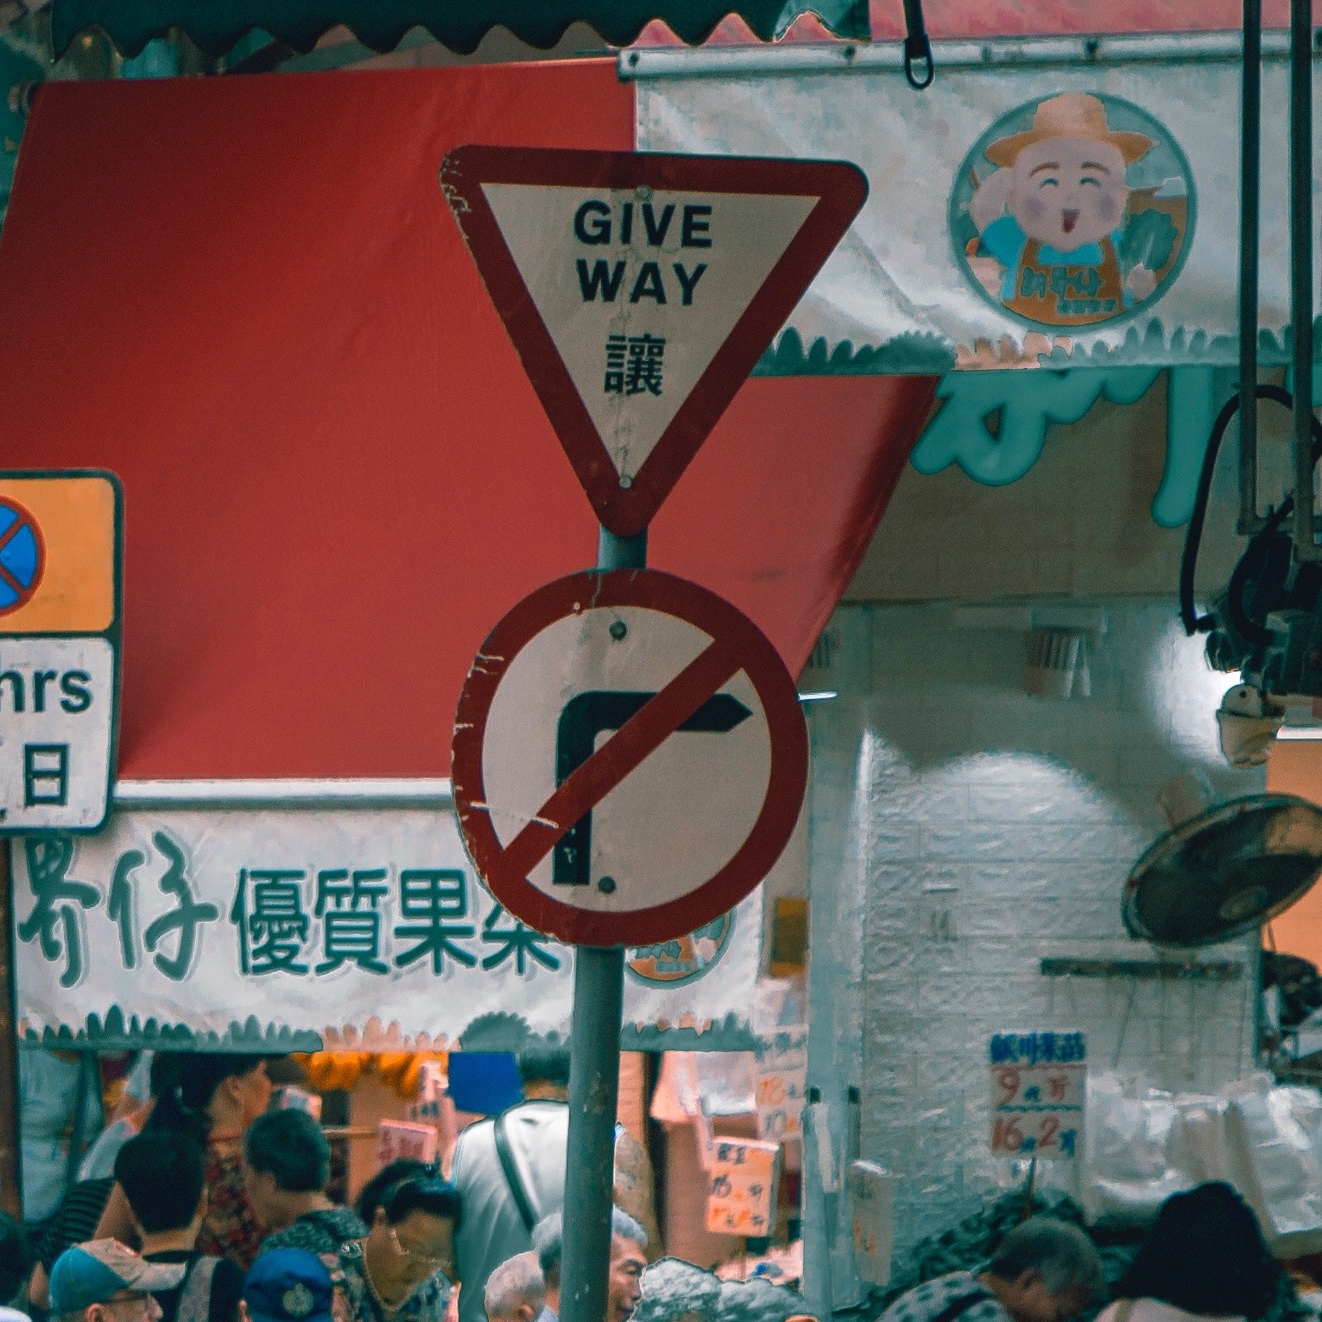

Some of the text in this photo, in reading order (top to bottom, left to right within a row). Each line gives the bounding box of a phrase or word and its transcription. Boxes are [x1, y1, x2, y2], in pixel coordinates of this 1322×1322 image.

[574, 200, 713, 248] GIVE
[576, 258, 708, 306] WAY
[604, 332, 667, 396] 讓
